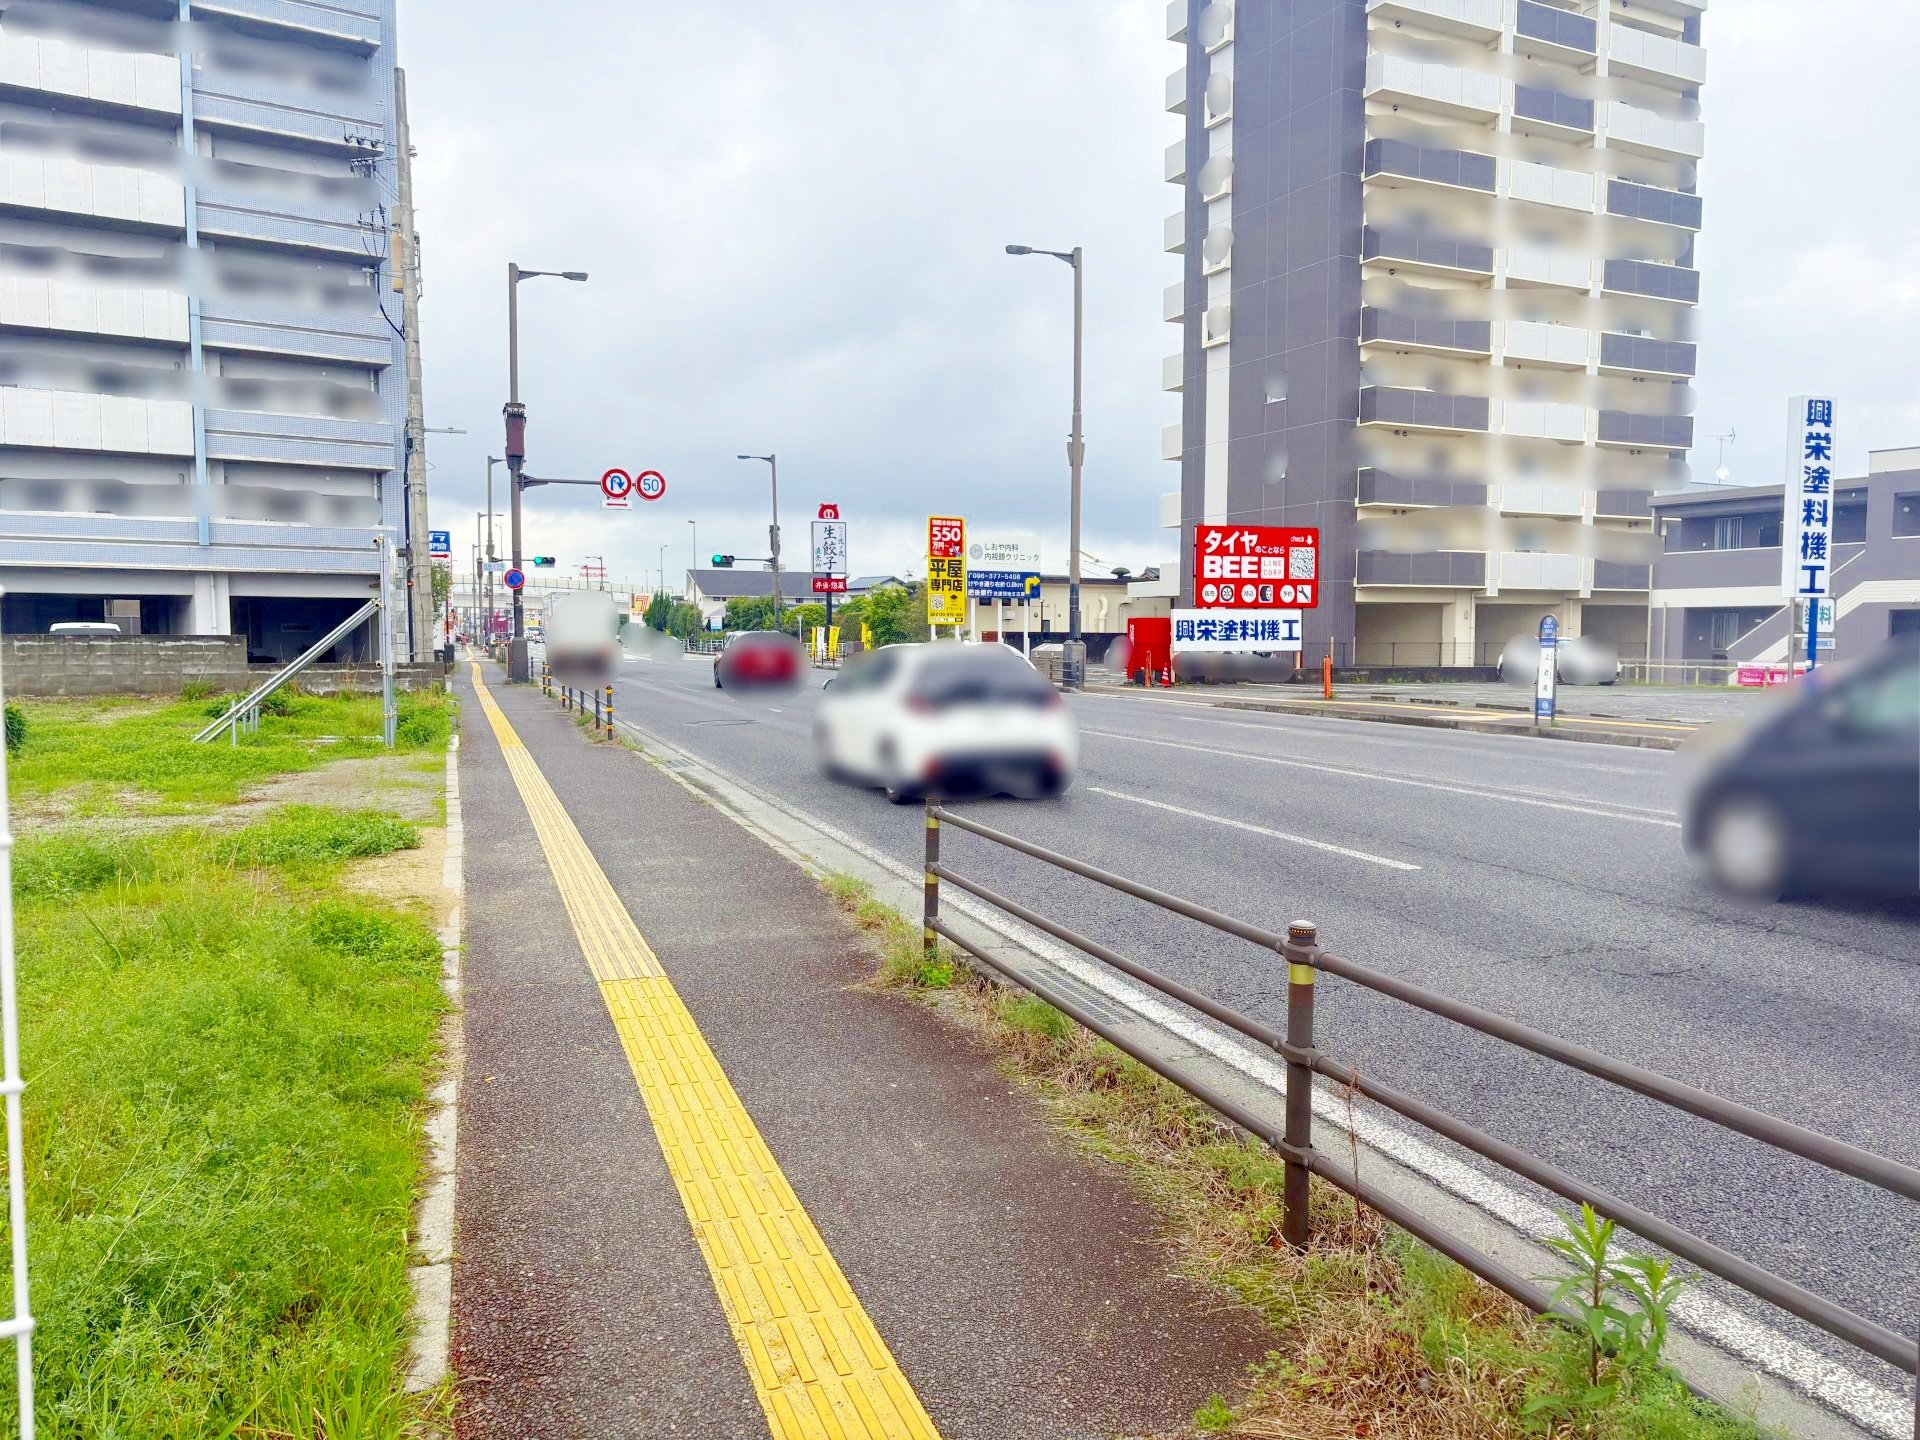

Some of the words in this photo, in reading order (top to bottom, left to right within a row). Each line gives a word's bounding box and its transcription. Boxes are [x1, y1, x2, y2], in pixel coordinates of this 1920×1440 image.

[643, 478, 659, 492] 50
[1798, 398, 1833, 594] 興栄塗料機工
[931, 526, 961, 542] 550
[1204, 529, 1259, 555] タイヤ
[1254, 546, 1286, 554] のことなら
[823, 525, 838, 571] 生餃子
[984, 543, 1019, 551] しおや内科
[930, 558, 962, 578] 平屋
[1203, 554, 1259, 579] BEE
[930, 579, 962, 592] 専門店
[1175, 619, 1300, 642] 興栄塗料機工
